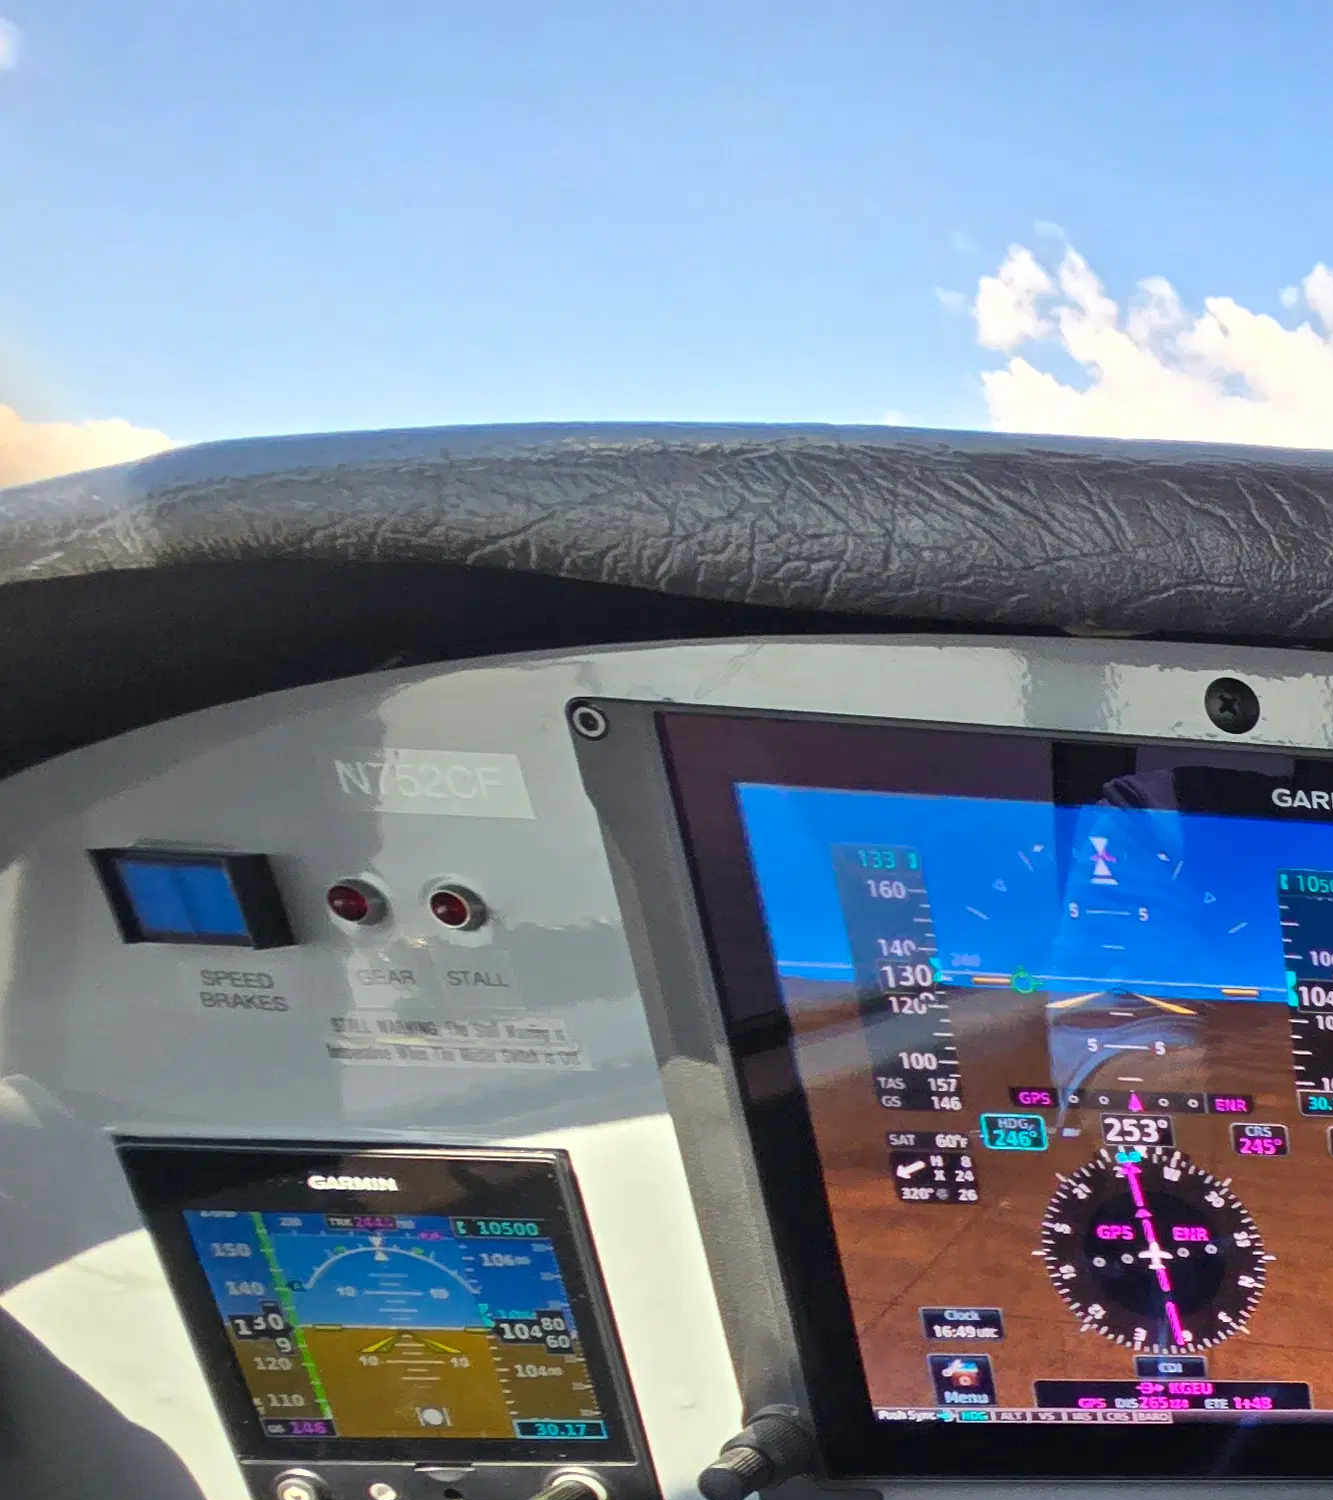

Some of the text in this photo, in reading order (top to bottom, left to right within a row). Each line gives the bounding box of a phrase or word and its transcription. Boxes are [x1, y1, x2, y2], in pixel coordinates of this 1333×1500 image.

[334, 758, 504, 803] N752CF
[857, 850, 896, 869] 133
[868, 880, 907, 899] 160
[200, 969, 275, 990] SPEED
[355, 969, 416, 988] GEAR
[447, 969, 509, 989] STALL
[882, 965, 932, 988] 130
[200, 991, 289, 1013] BRAKES
[900, 1052, 937, 1070] 100
[878, 1076, 956, 1092] TAS 157
[932, 1094, 961, 1110] 146
[1019, 1090, 1051, 1105] GPS
[1105, 1118, 1169, 1143] 253°
[308, 1175, 398, 1191] GARMIN
[476, 1221, 538, 1237] 10500
[255, 1356, 292, 1371] 120
[289, 1420, 328, 1435] 146
[536, 1422, 587, 1437] 30.17
